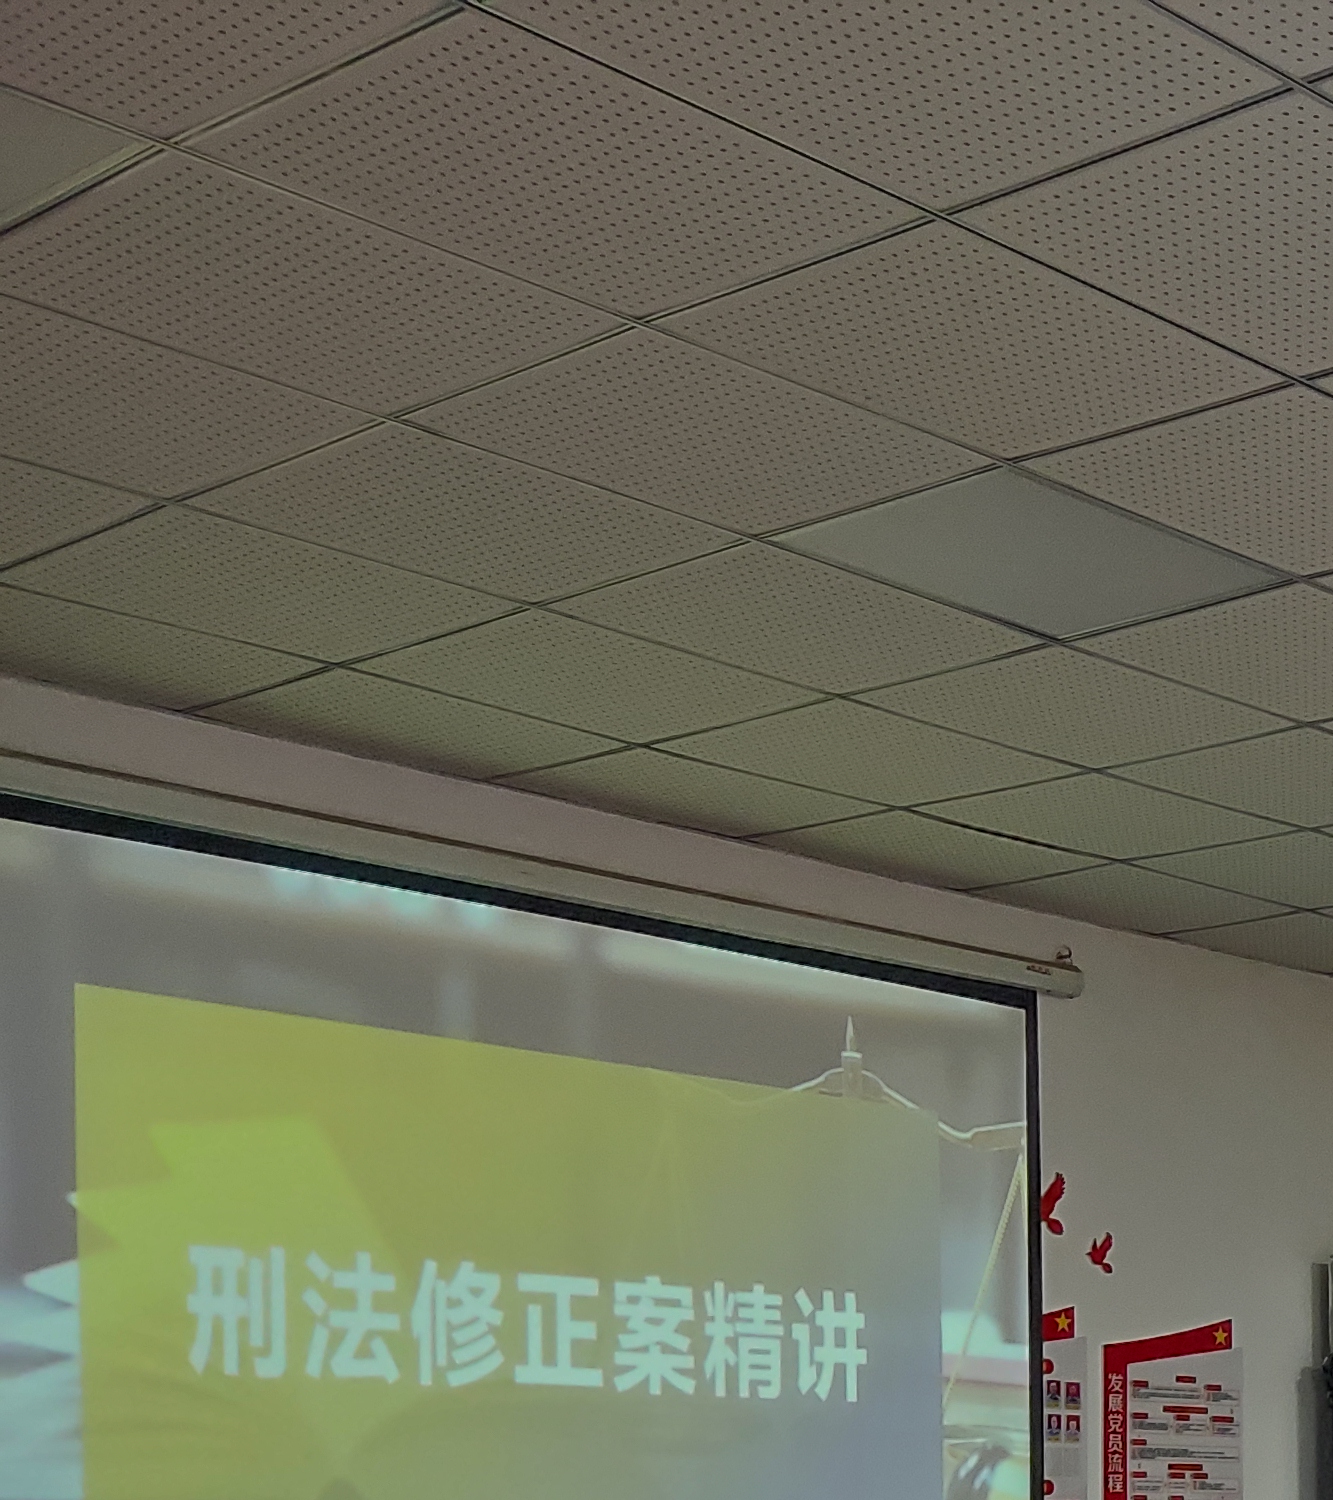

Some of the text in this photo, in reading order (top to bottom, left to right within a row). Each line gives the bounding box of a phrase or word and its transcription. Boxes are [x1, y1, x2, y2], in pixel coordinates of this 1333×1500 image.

[187, 1244, 867, 1403] 刑法修正案精讲
[1107, 1372, 1124, 1494] 发展党员流程
